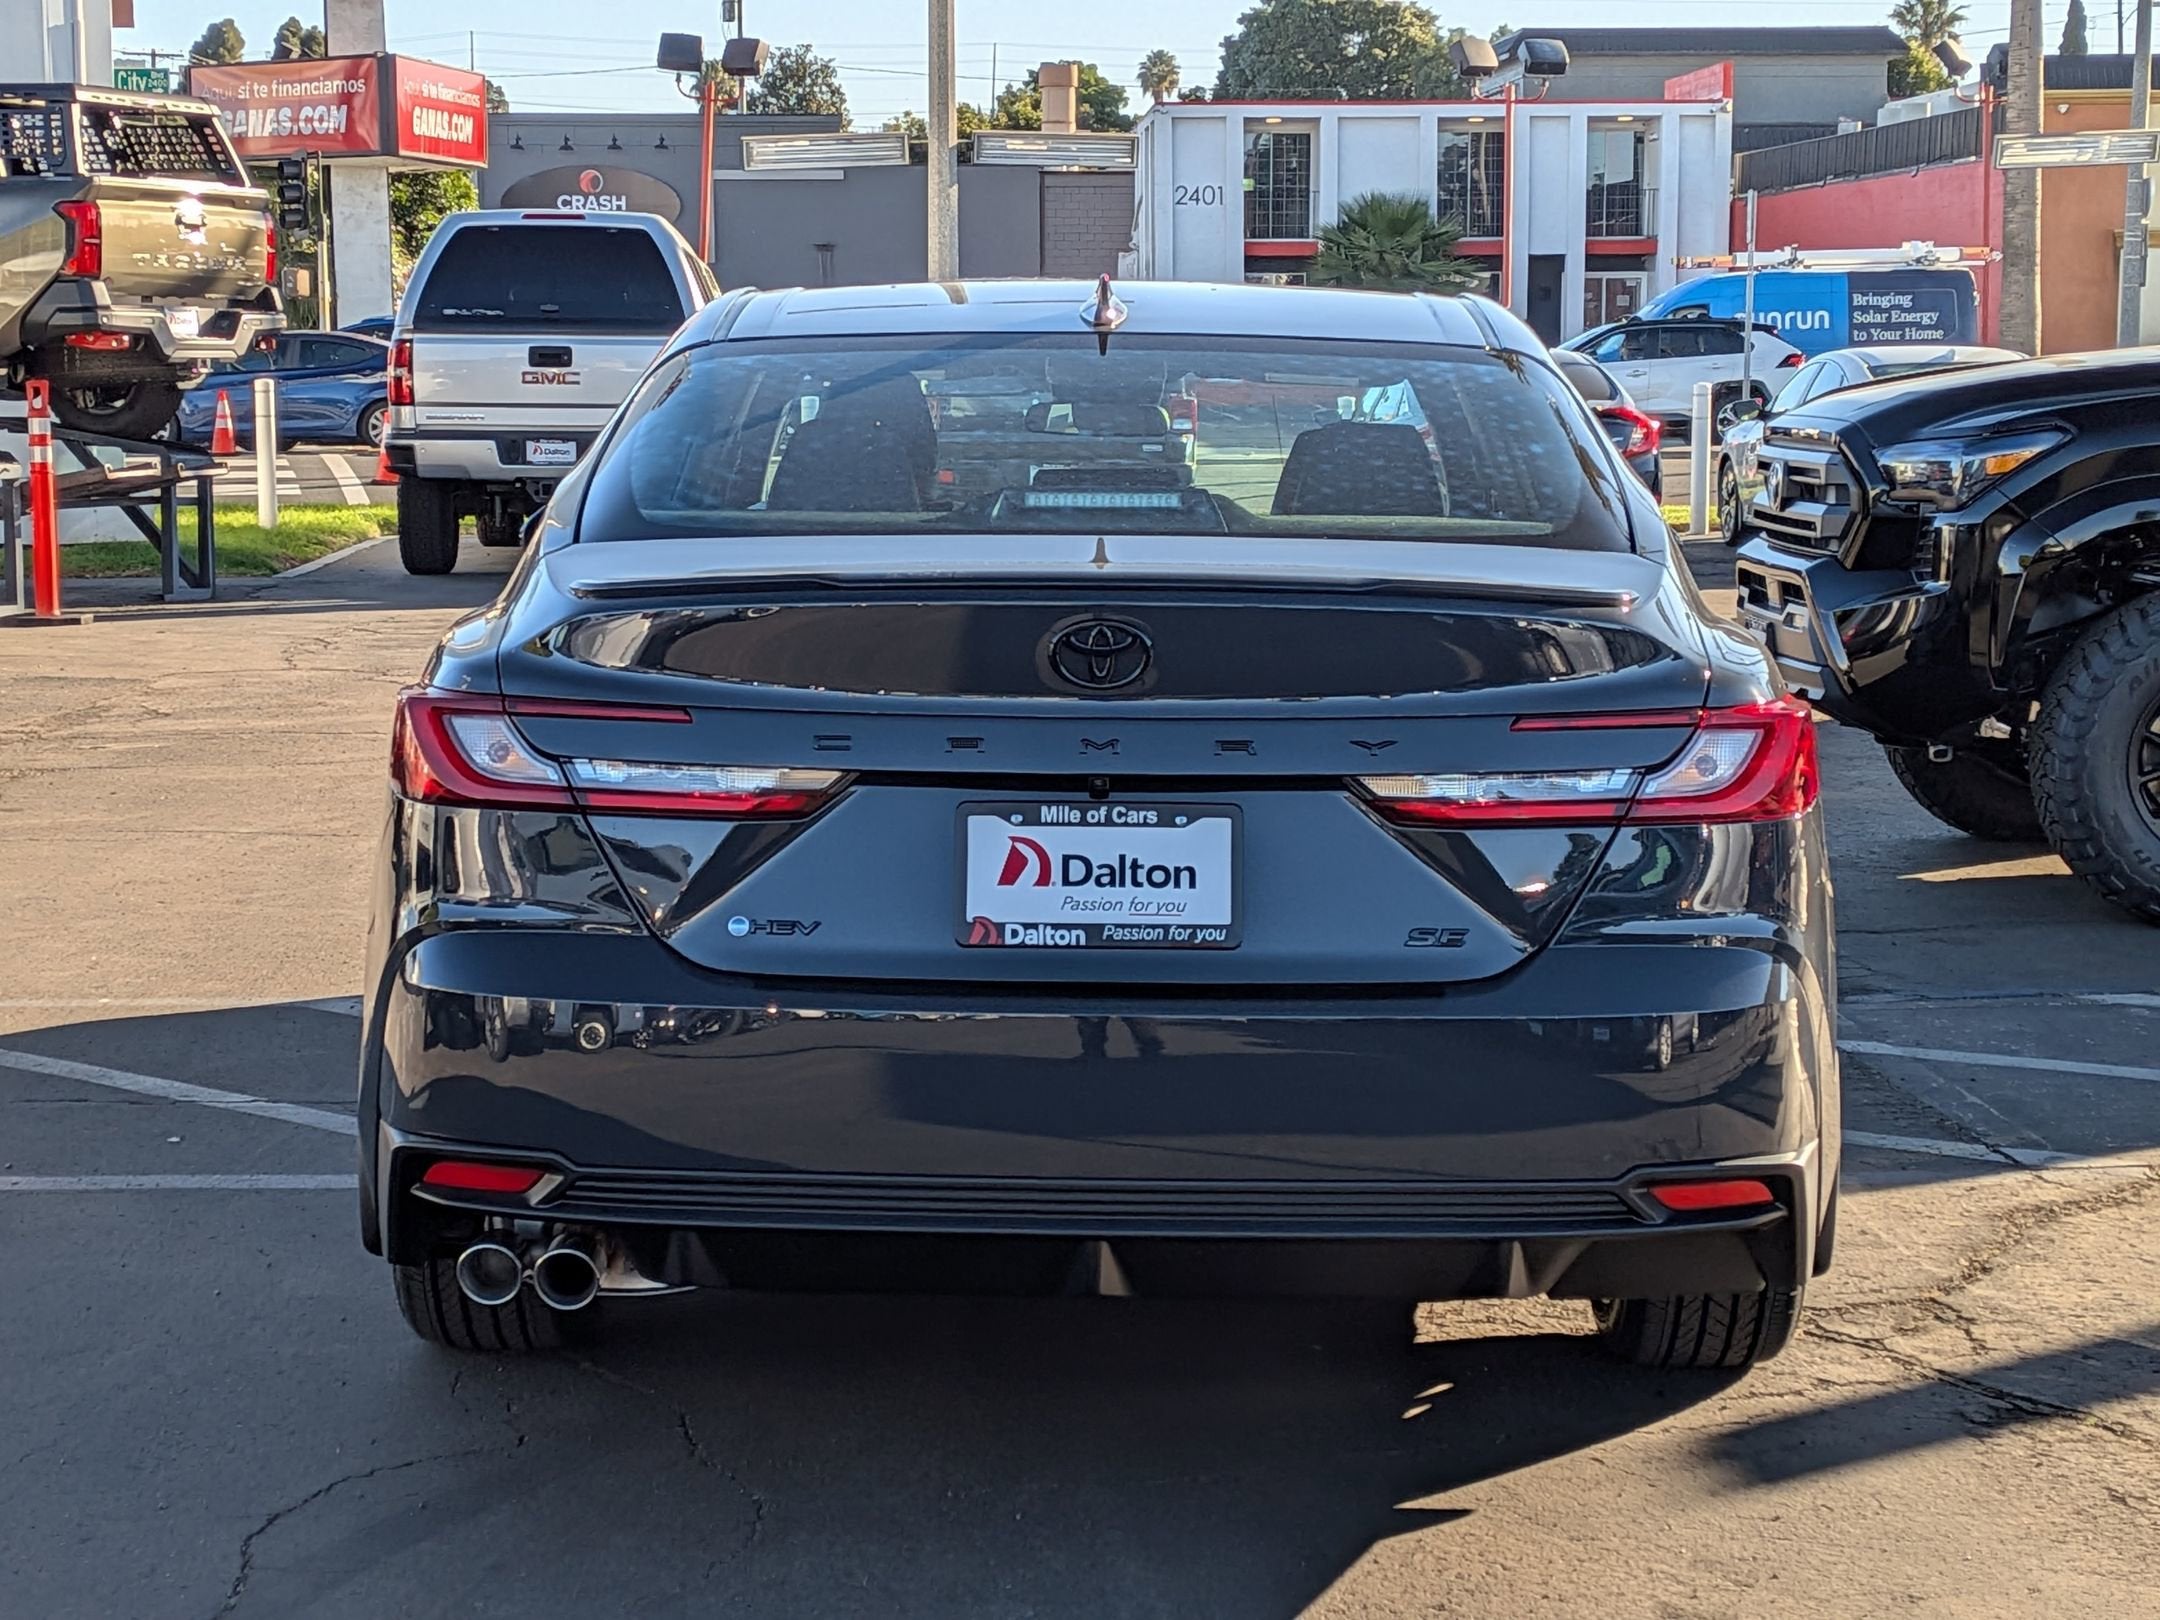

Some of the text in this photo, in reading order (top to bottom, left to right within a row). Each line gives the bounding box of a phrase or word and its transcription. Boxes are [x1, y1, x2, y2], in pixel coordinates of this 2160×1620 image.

[117, 71, 148, 92] City
[253, 81, 268, 98] te
[272, 77, 366, 97] financiamos
[412, 105, 474, 145] GANAS.COM
[557, 194, 627, 211] CRASH
[1175, 184, 1223, 206] 2401
[1852, 292, 1913, 308] Bringing
[1852, 310, 1940, 325] Solar Energy
[1853, 327, 1945, 342] to Your Home
[521, 371, 581, 385] GMC
[811, 734, 1399, 756] CAMRY
[1040, 806, 1159, 824] Mile of Cars
[1060, 853, 1197, 889] Dalton
[1060, 896, 1188, 914] Passion for you
[750, 919, 823, 937] HEV
[1004, 924, 1227, 946] Dalton Passion for you
[1403, 927, 1471, 948] SE
